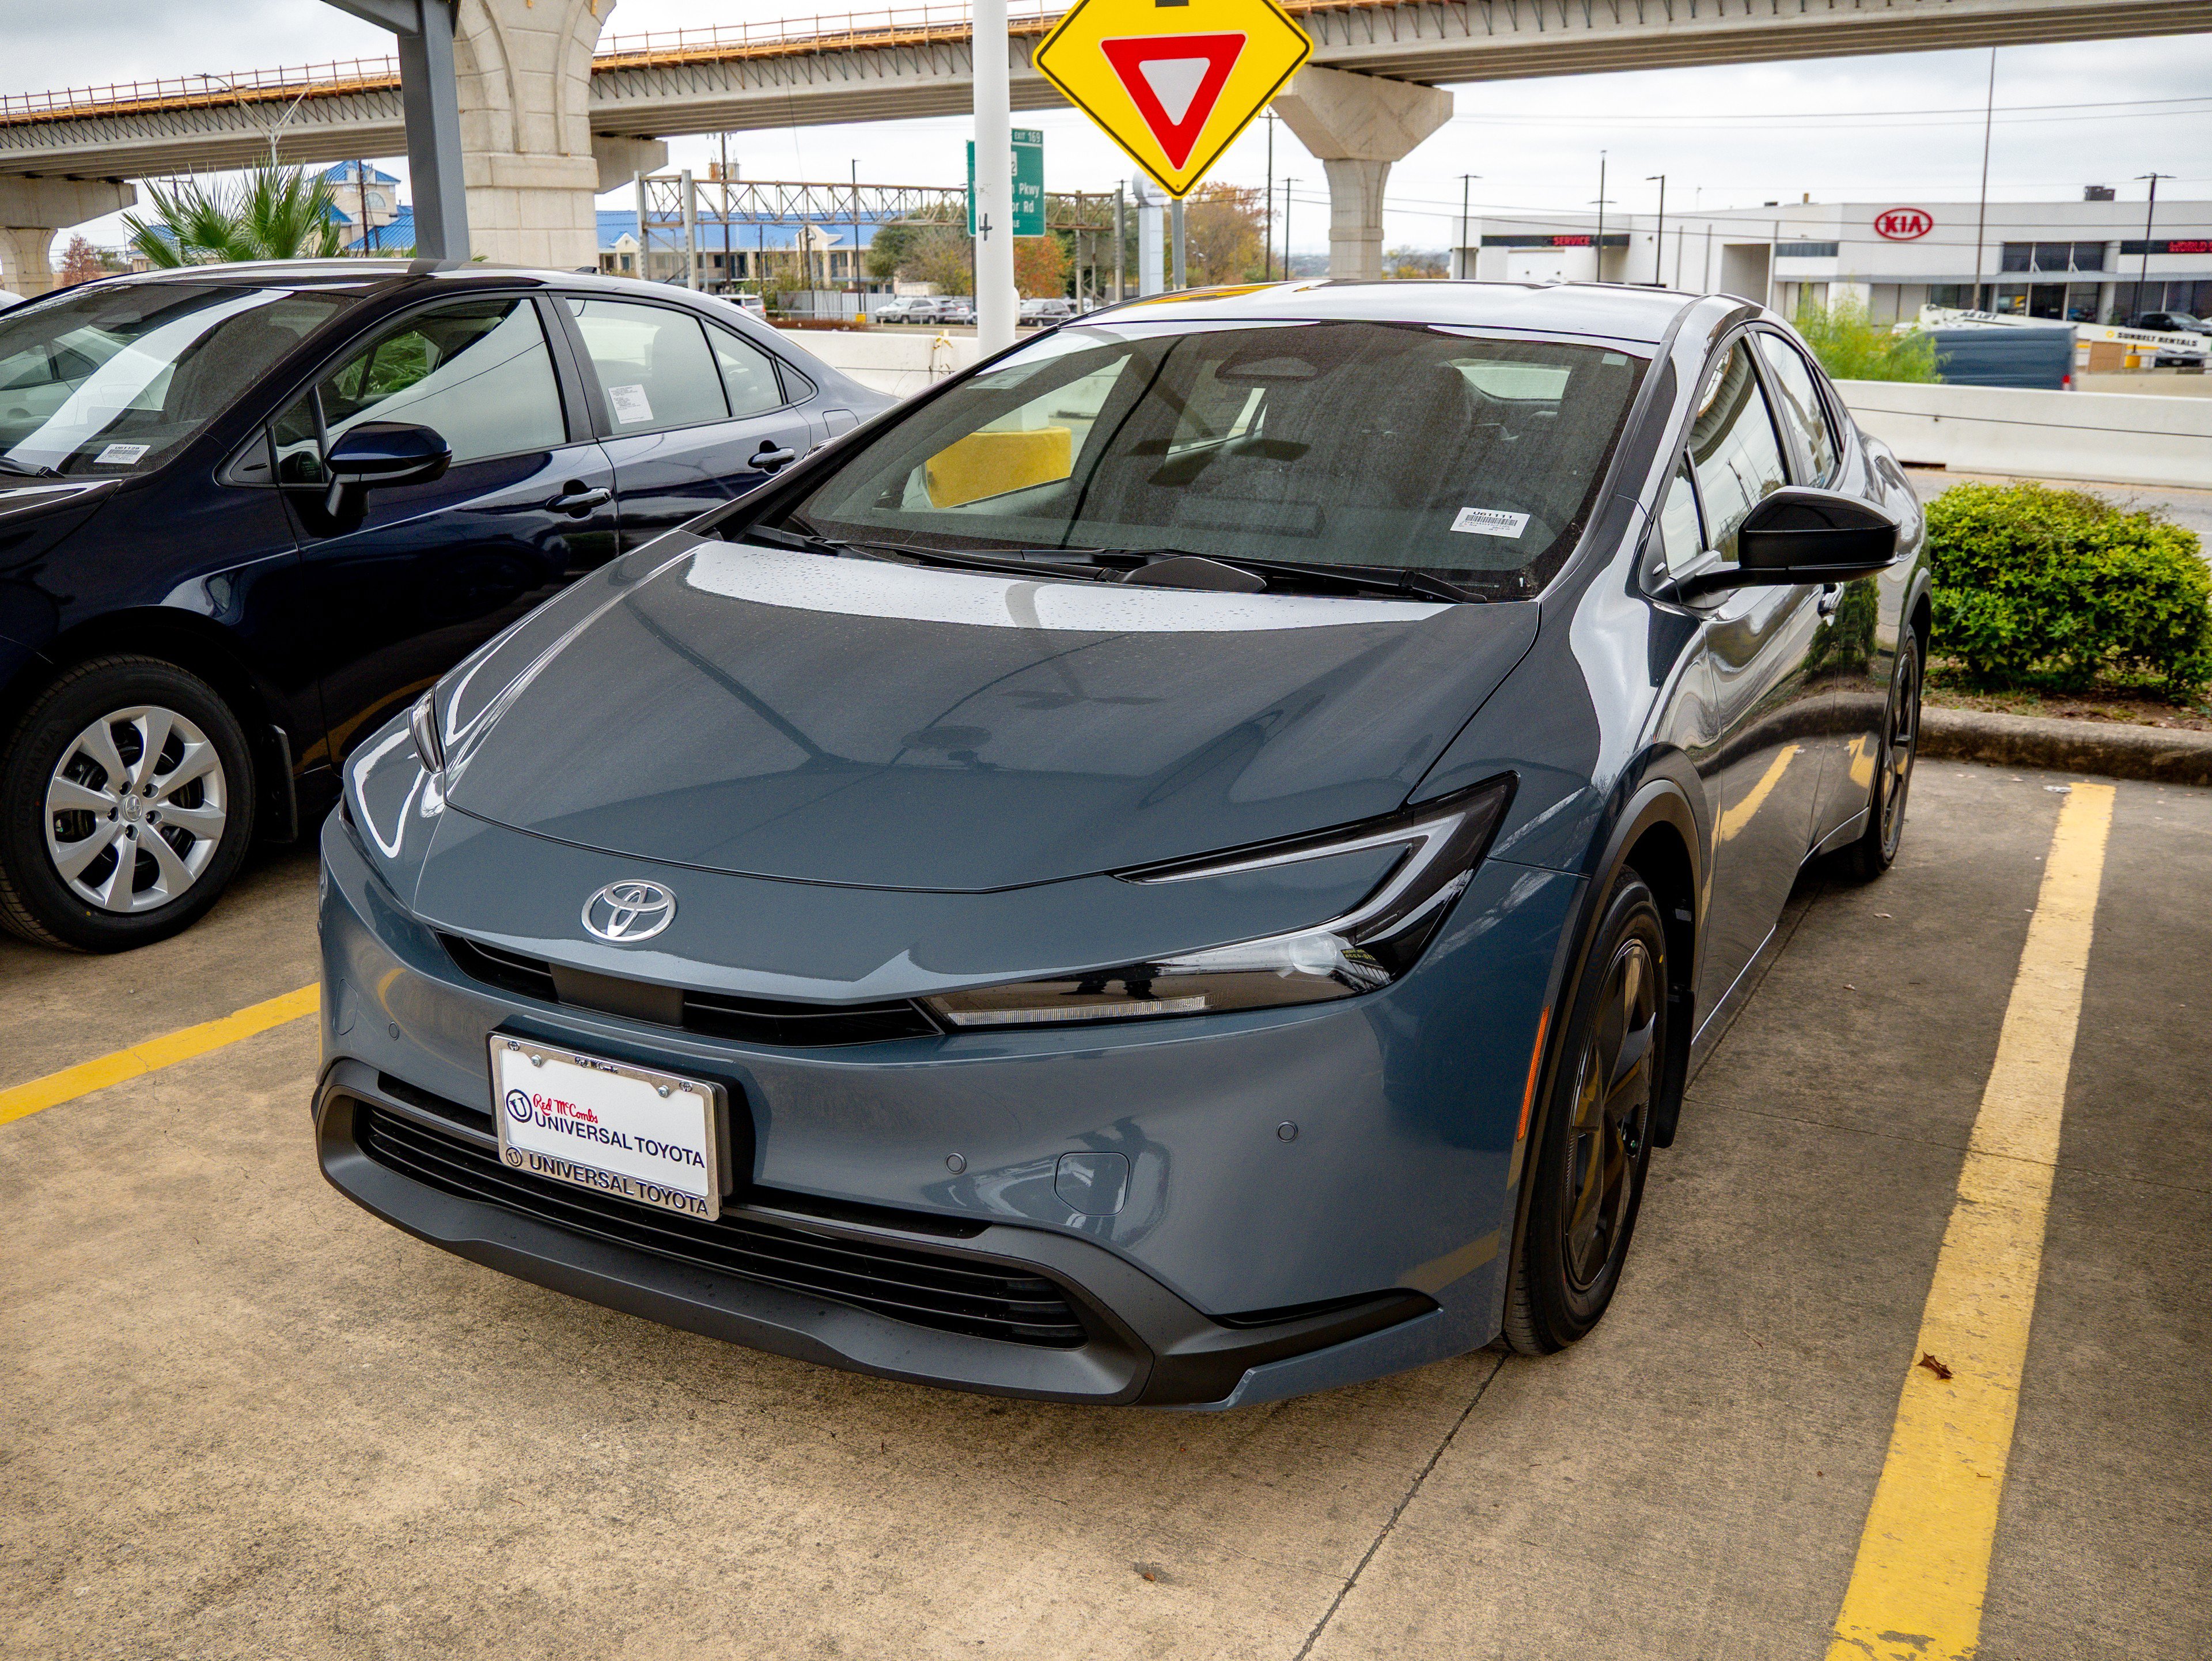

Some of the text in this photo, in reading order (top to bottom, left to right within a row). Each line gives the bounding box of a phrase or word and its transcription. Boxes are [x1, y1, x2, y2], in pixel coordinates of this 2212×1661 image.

[1014, 131, 1041, 143] EXIT 169
[1019, 183, 1040, 198] Pkwy
[1023, 200, 1035, 213] Rd
[1552, 236, 1590, 245] SERVICE
[533, 1094, 552, 1116] Red
[553, 1099, 599, 1123] McCombs
[535, 1111, 705, 1168] UNIVERSAL TOYOTA
[529, 1152, 637, 1194] UNIVERSAL
[636, 1182, 709, 1215] TOYOTA
